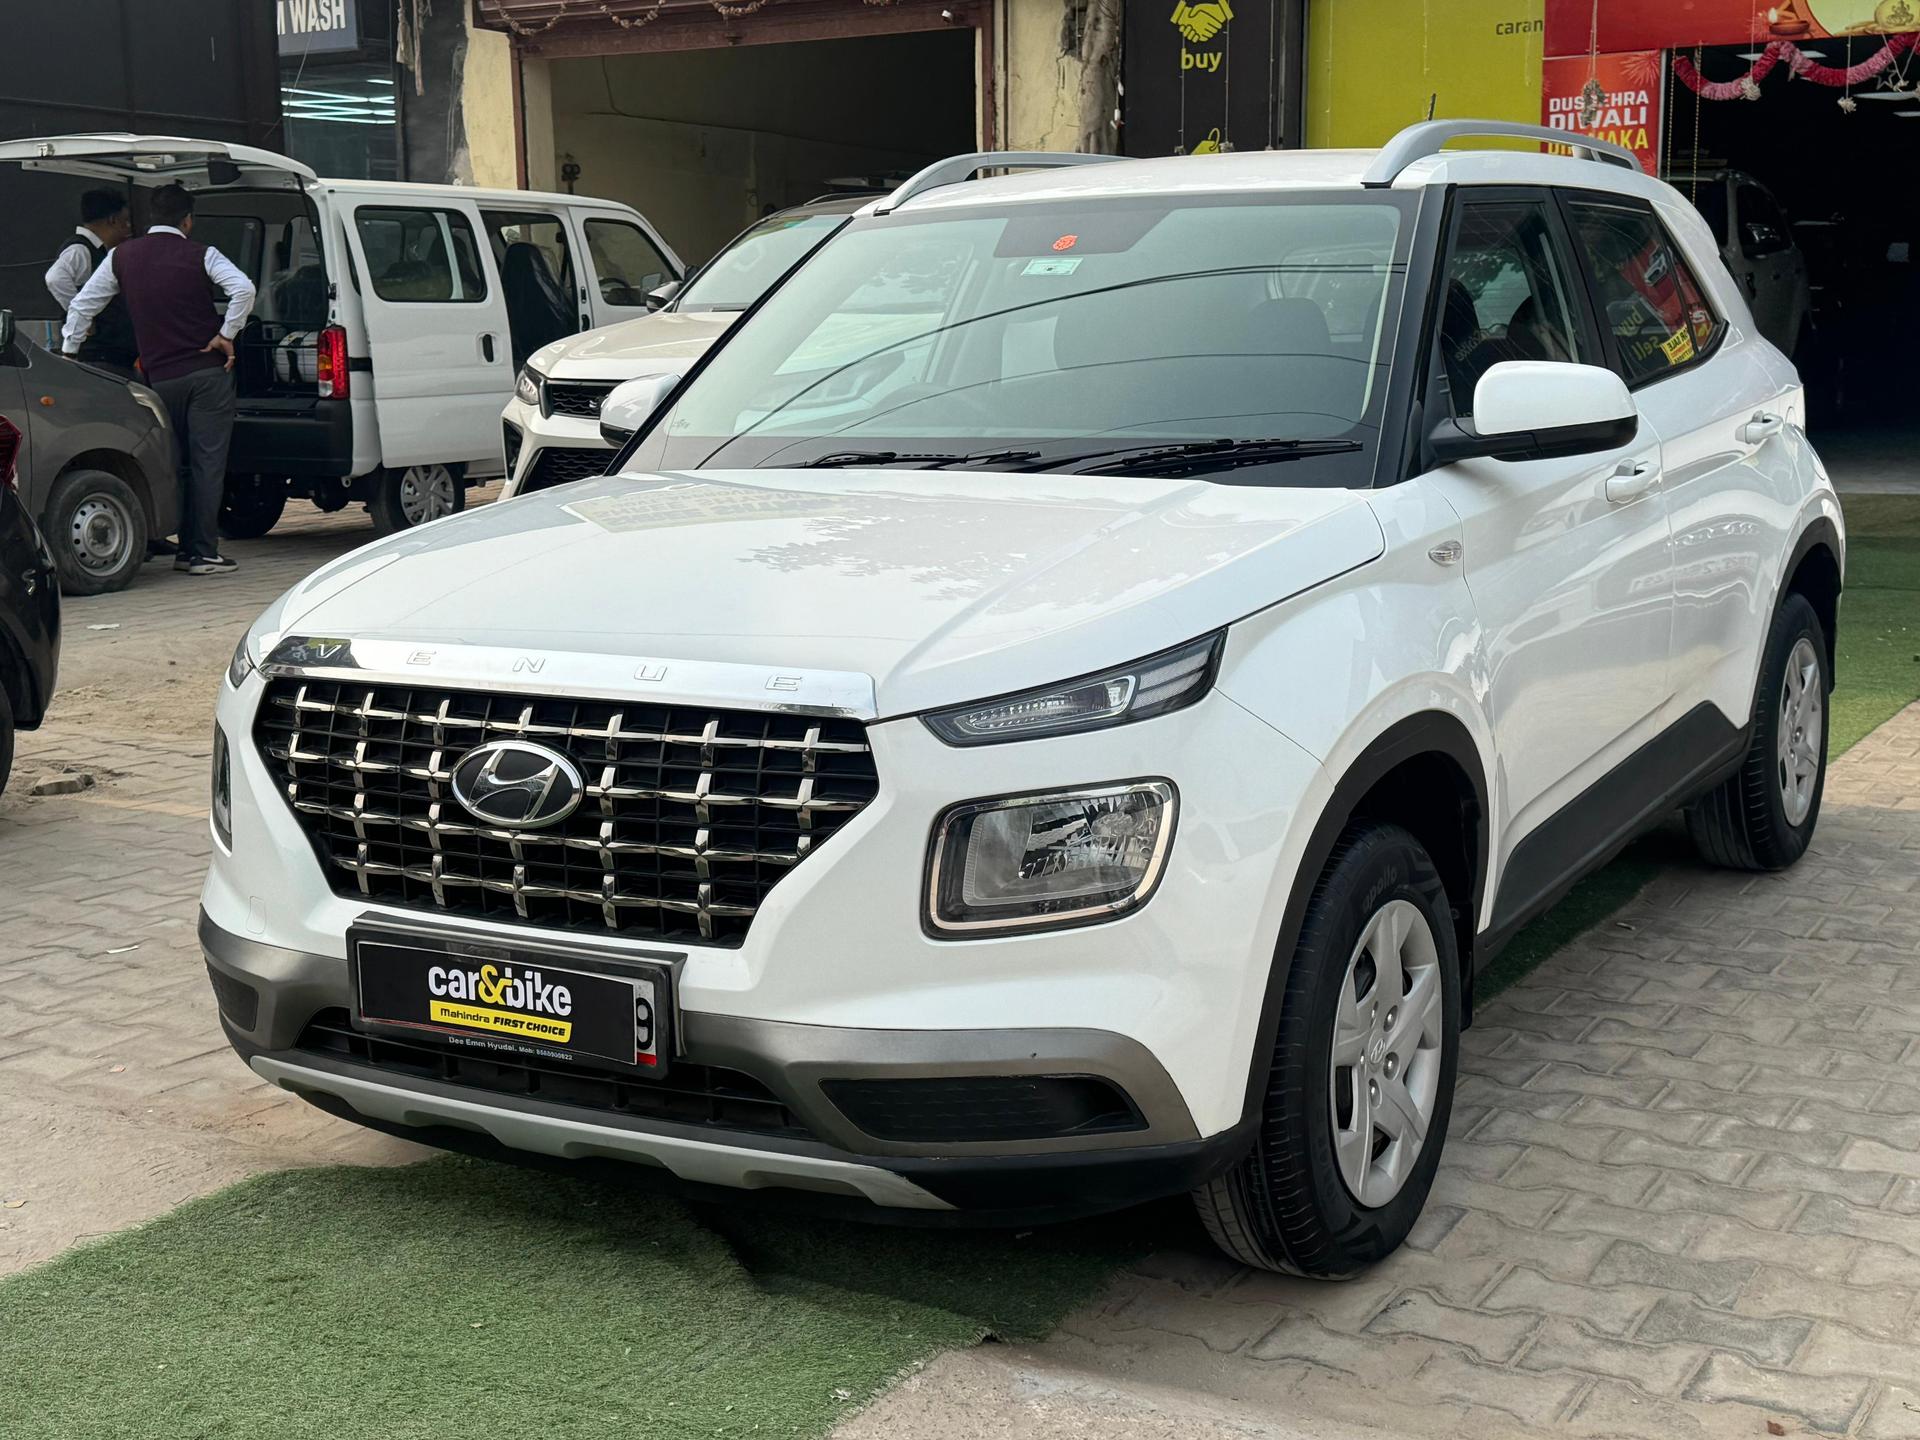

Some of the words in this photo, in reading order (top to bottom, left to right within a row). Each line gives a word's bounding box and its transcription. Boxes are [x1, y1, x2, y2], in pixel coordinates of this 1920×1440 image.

[289, 0, 346, 34] WASH
[1496, 20, 1543, 35] caran
[1181, 48, 1222, 72] buy
[1549, 90, 1649, 112] DUSEHRA
[1549, 106, 1647, 131] DIWALI
[316, 643, 803, 692] VENUE
[428, 964, 572, 1016] car&bike
[440, 1007, 490, 1024] Mahindra
[493, 1016, 527, 1029] FIRST
[526, 1021, 566, 1036] CHOICE
[636, 997, 654, 1050] 9
